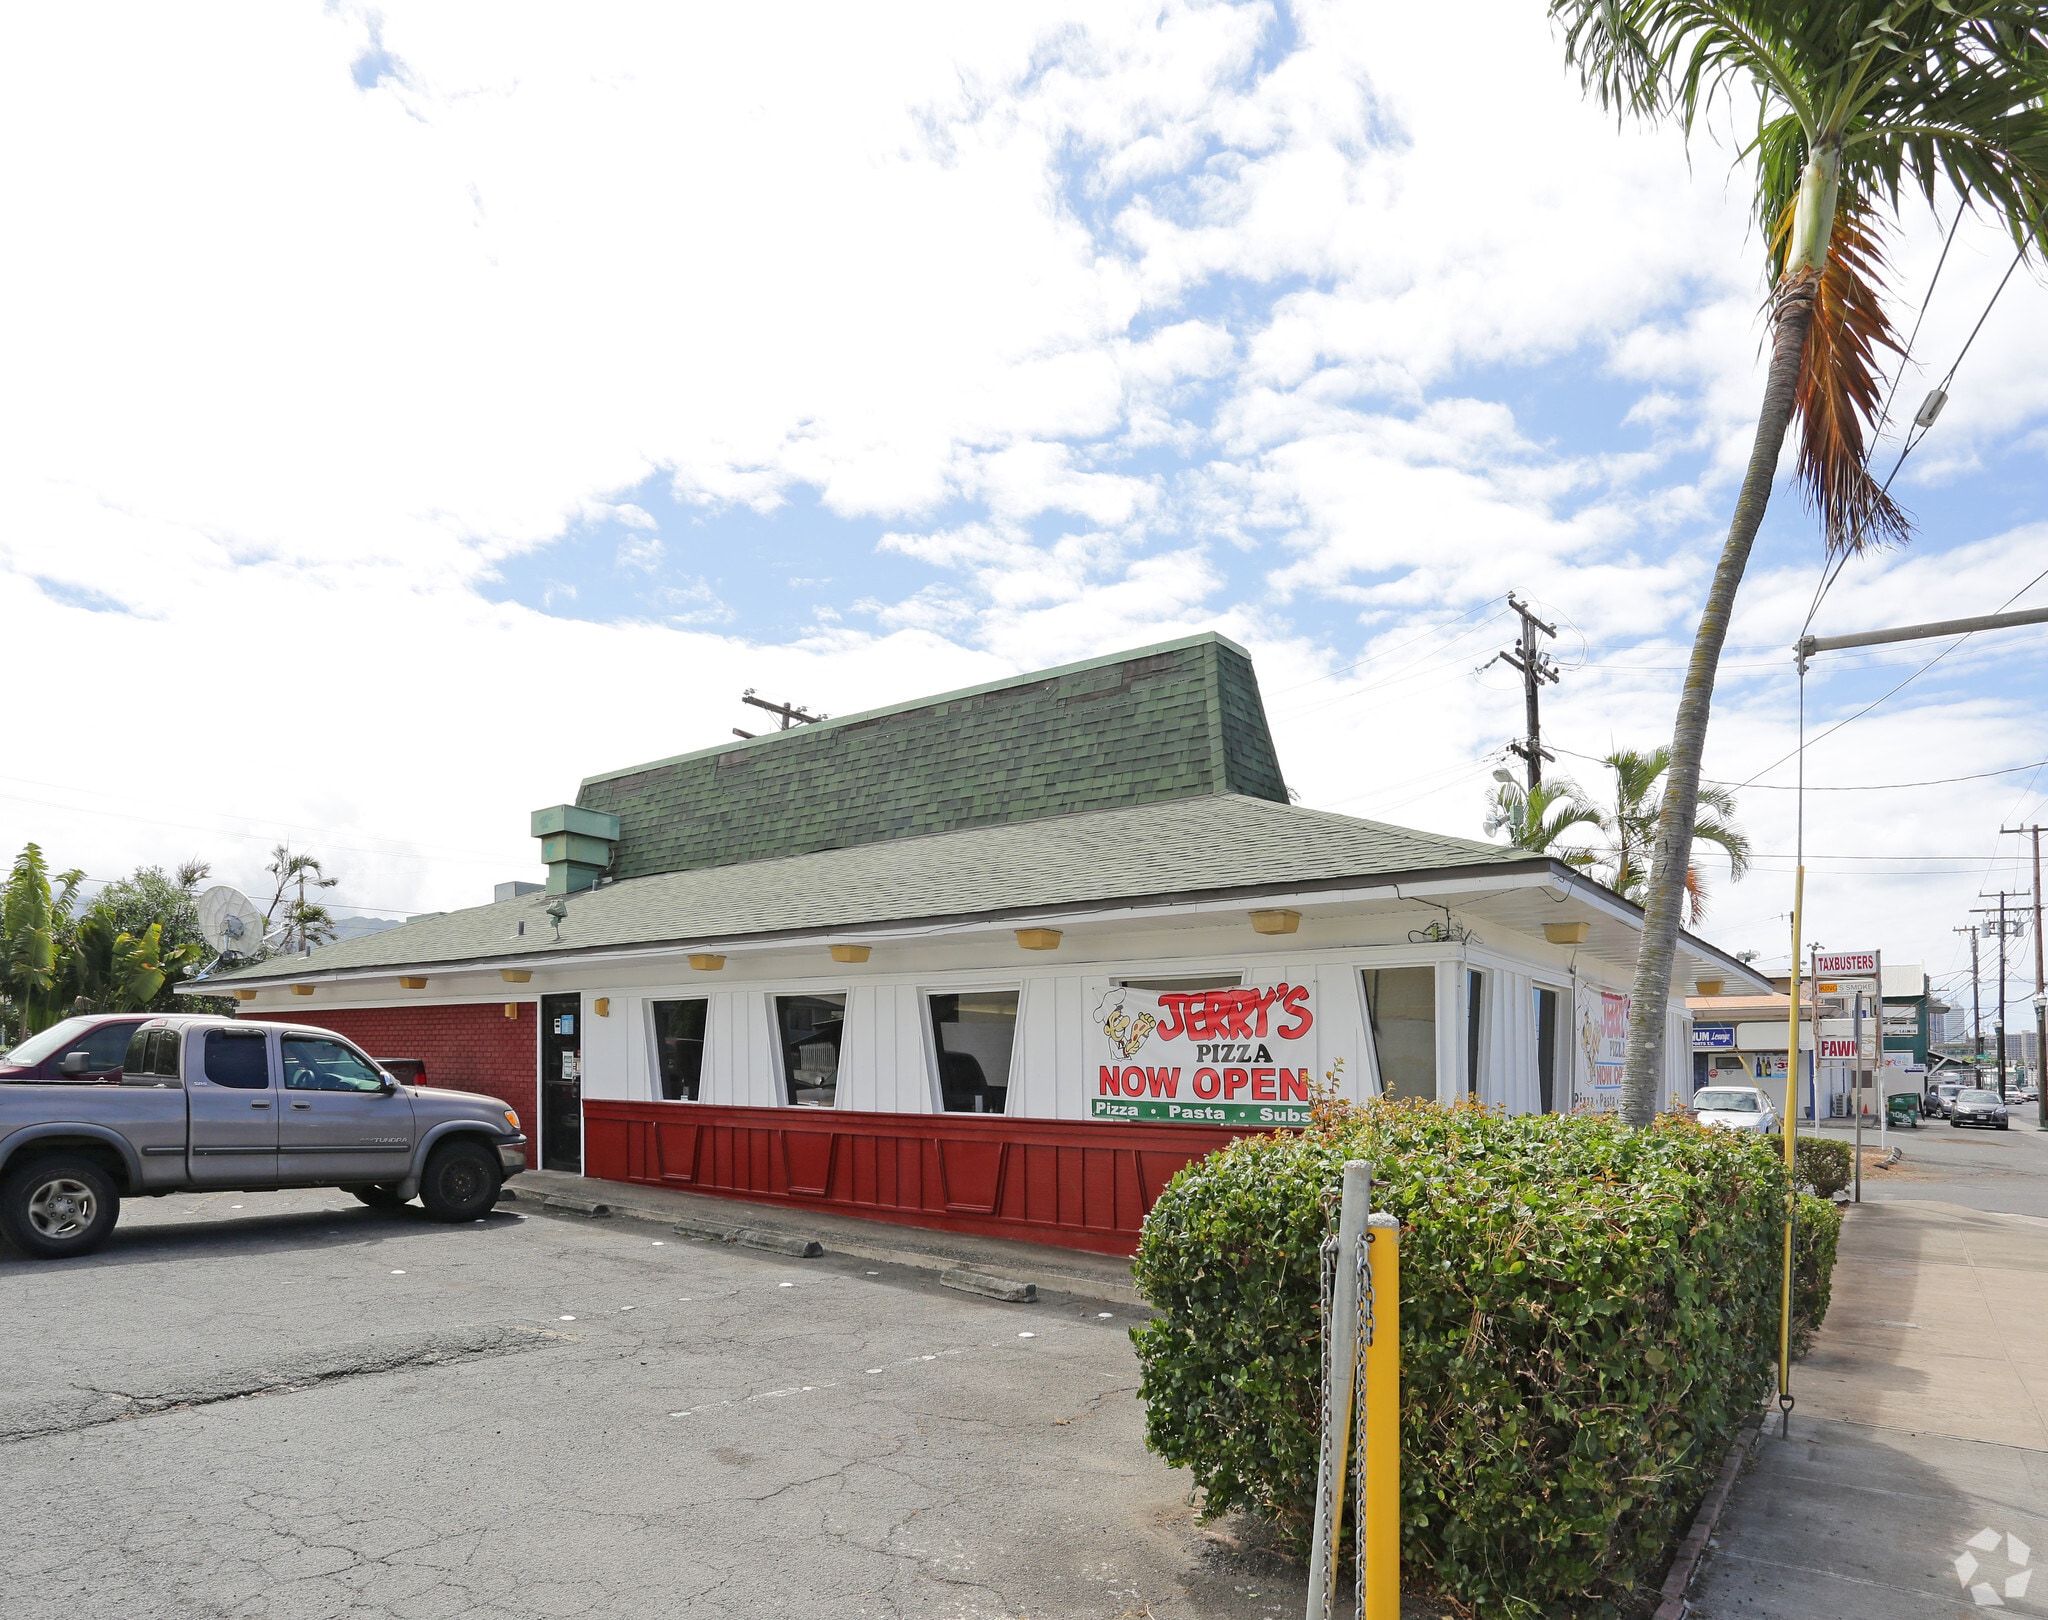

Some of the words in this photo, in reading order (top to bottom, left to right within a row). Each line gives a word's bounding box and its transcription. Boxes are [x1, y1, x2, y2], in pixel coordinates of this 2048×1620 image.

[1818, 955, 1874, 972] TAXBUSTERS
[1845, 983, 1873, 991] SMOKE
[1156, 982, 1314, 1042] JERRY'S
[1196, 1043, 1273, 1063] PIZZA
[1099, 1065, 1181, 1099] NOW
[1192, 1066, 1309, 1101] OPEN
[1095, 1101, 1139, 1117] Pizza
[1169, 1105, 1226, 1120] Pasta
[1260, 1107, 1312, 1123] Subs
